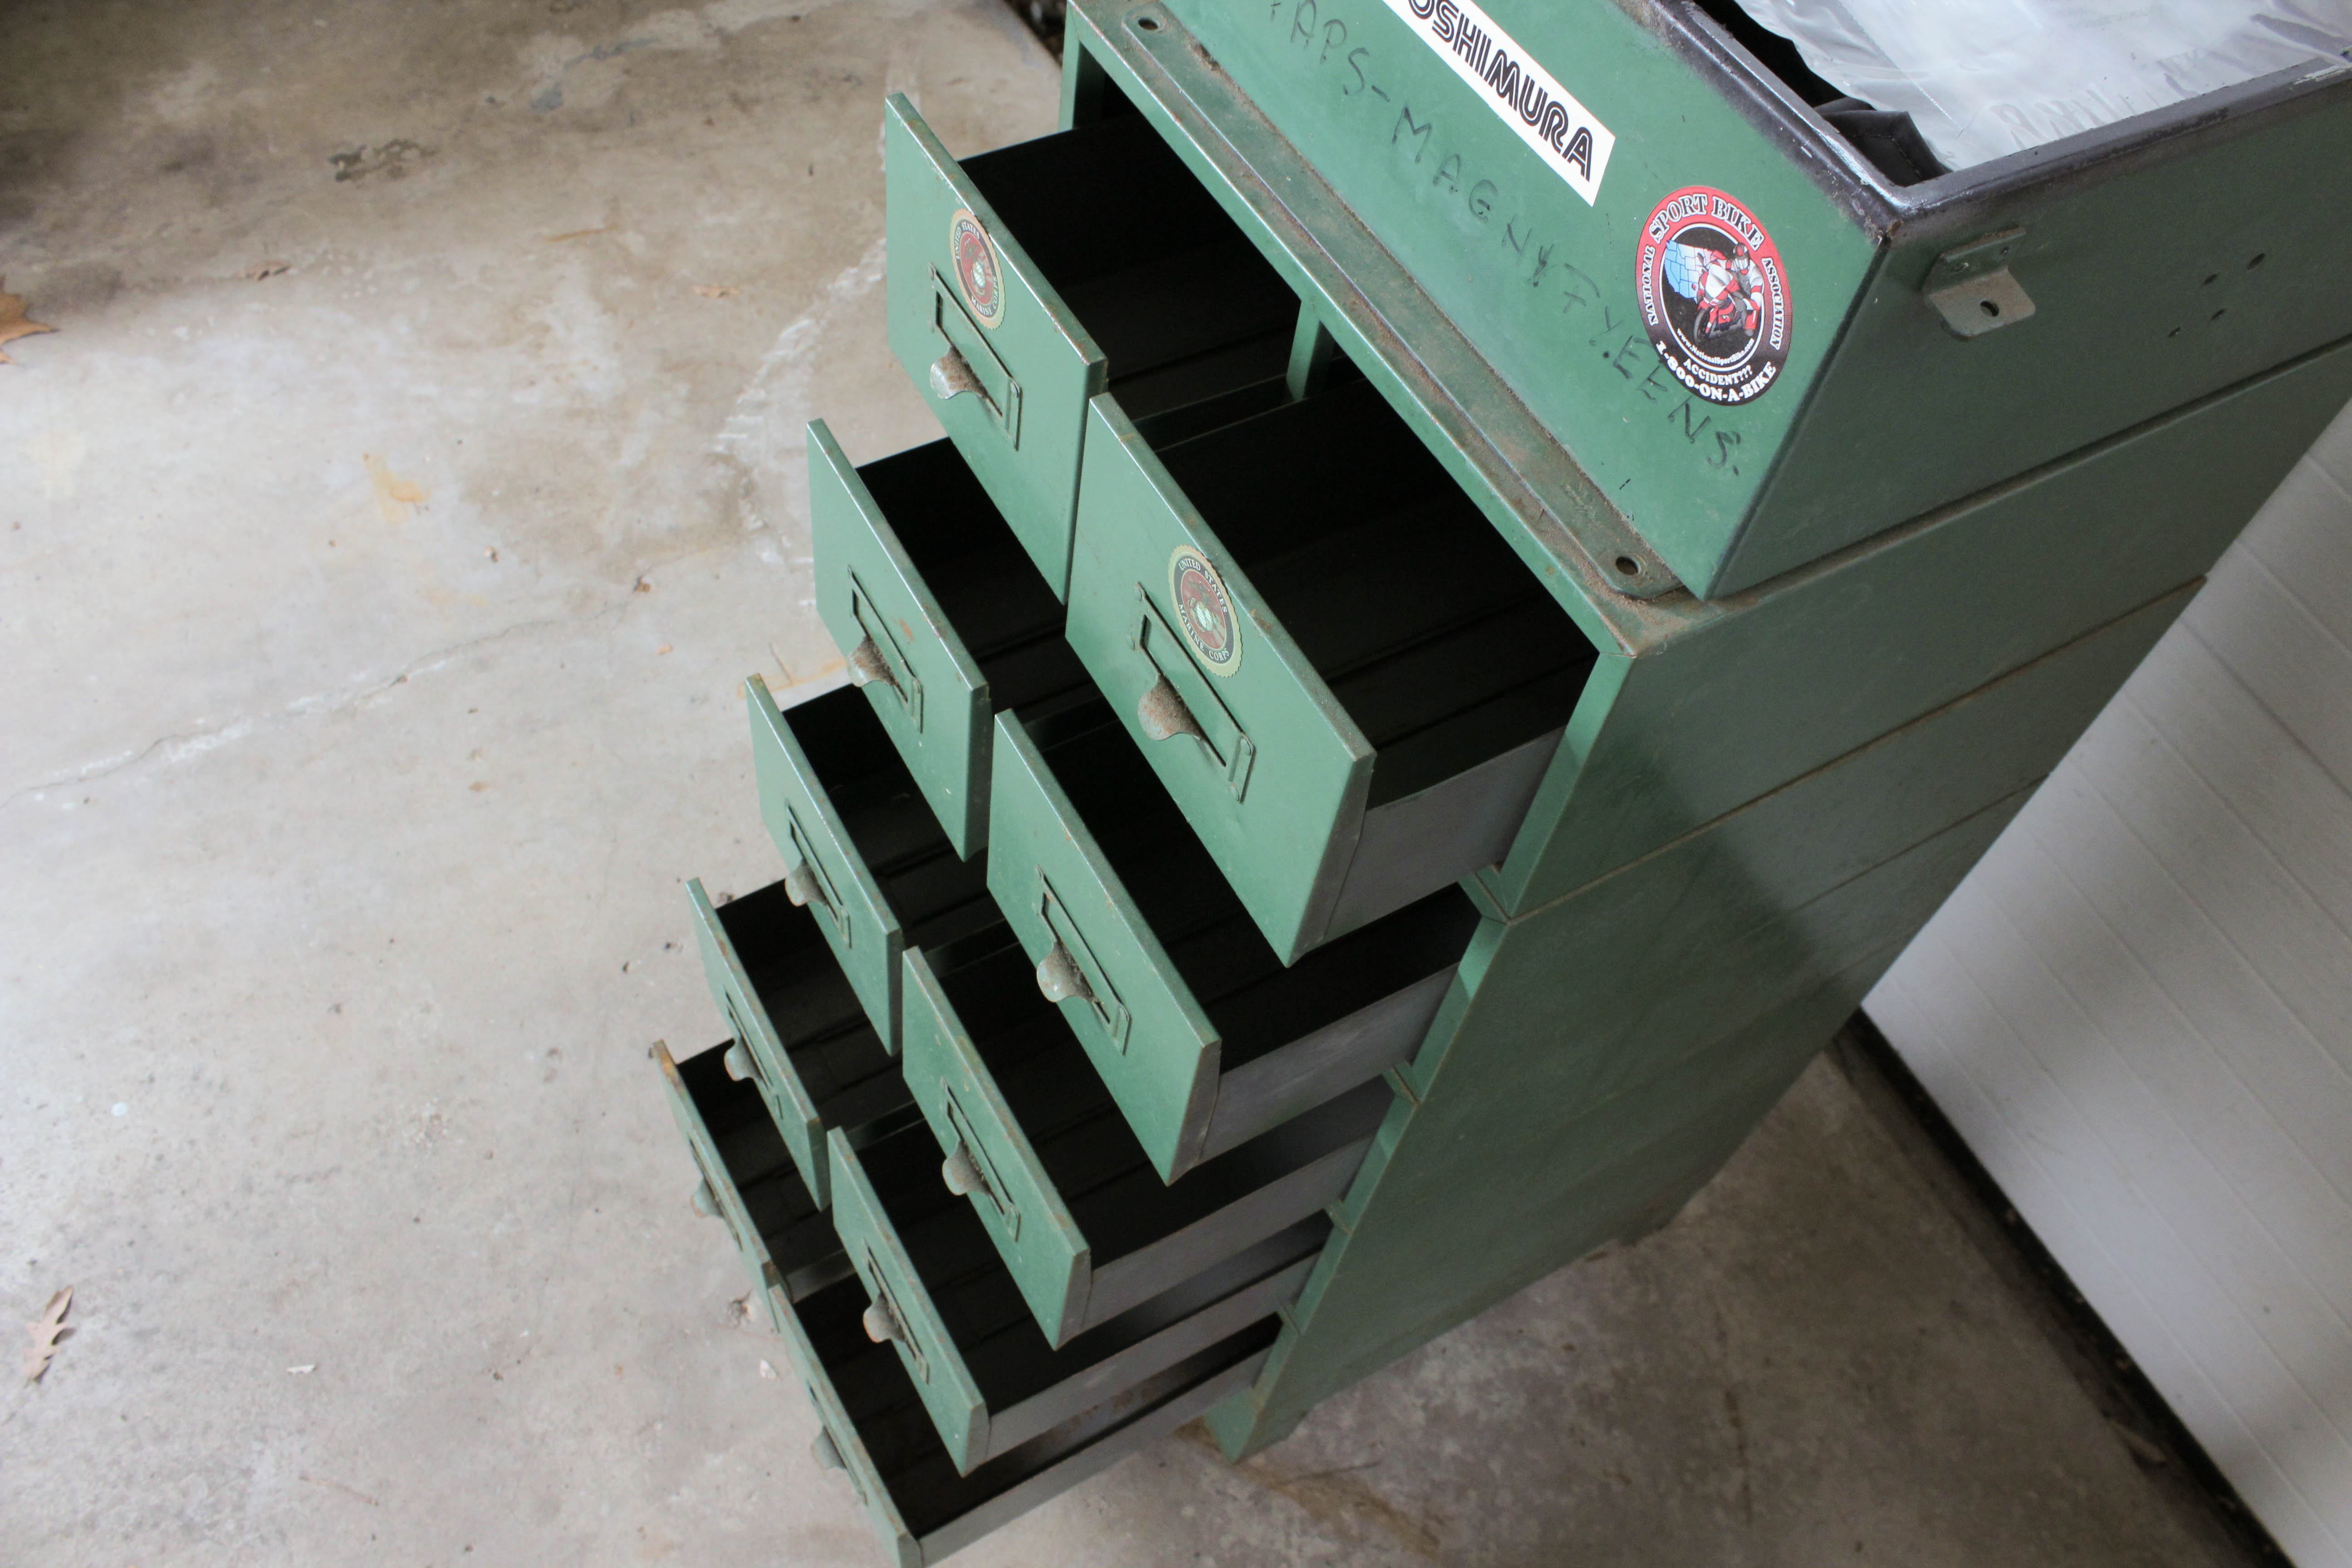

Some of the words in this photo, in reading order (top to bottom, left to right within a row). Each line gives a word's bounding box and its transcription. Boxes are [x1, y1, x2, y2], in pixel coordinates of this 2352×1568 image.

[961, 221, 980, 240] STATES
[1649, 193, 1708, 244] SPORT
[1712, 196, 1765, 251] BIKE
[970, 295, 993, 317] MARINE
[1642, 245, 1659, 326] NATIONAL
[1762, 257, 1784, 351] ASSOCIATION
[1656, 340, 1777, 402] 1-800-ON-A-BIKE
[1676, 328, 1755, 366] www.NationalSportBike.com
[1683, 358, 1752, 386] ACCIDENT???
[1178, 558, 1201, 571] UNITED
[1204, 570, 1228, 613] STATES
[1178, 604, 1205, 651] MARINE
[1209, 648, 1230, 662] CORPS
